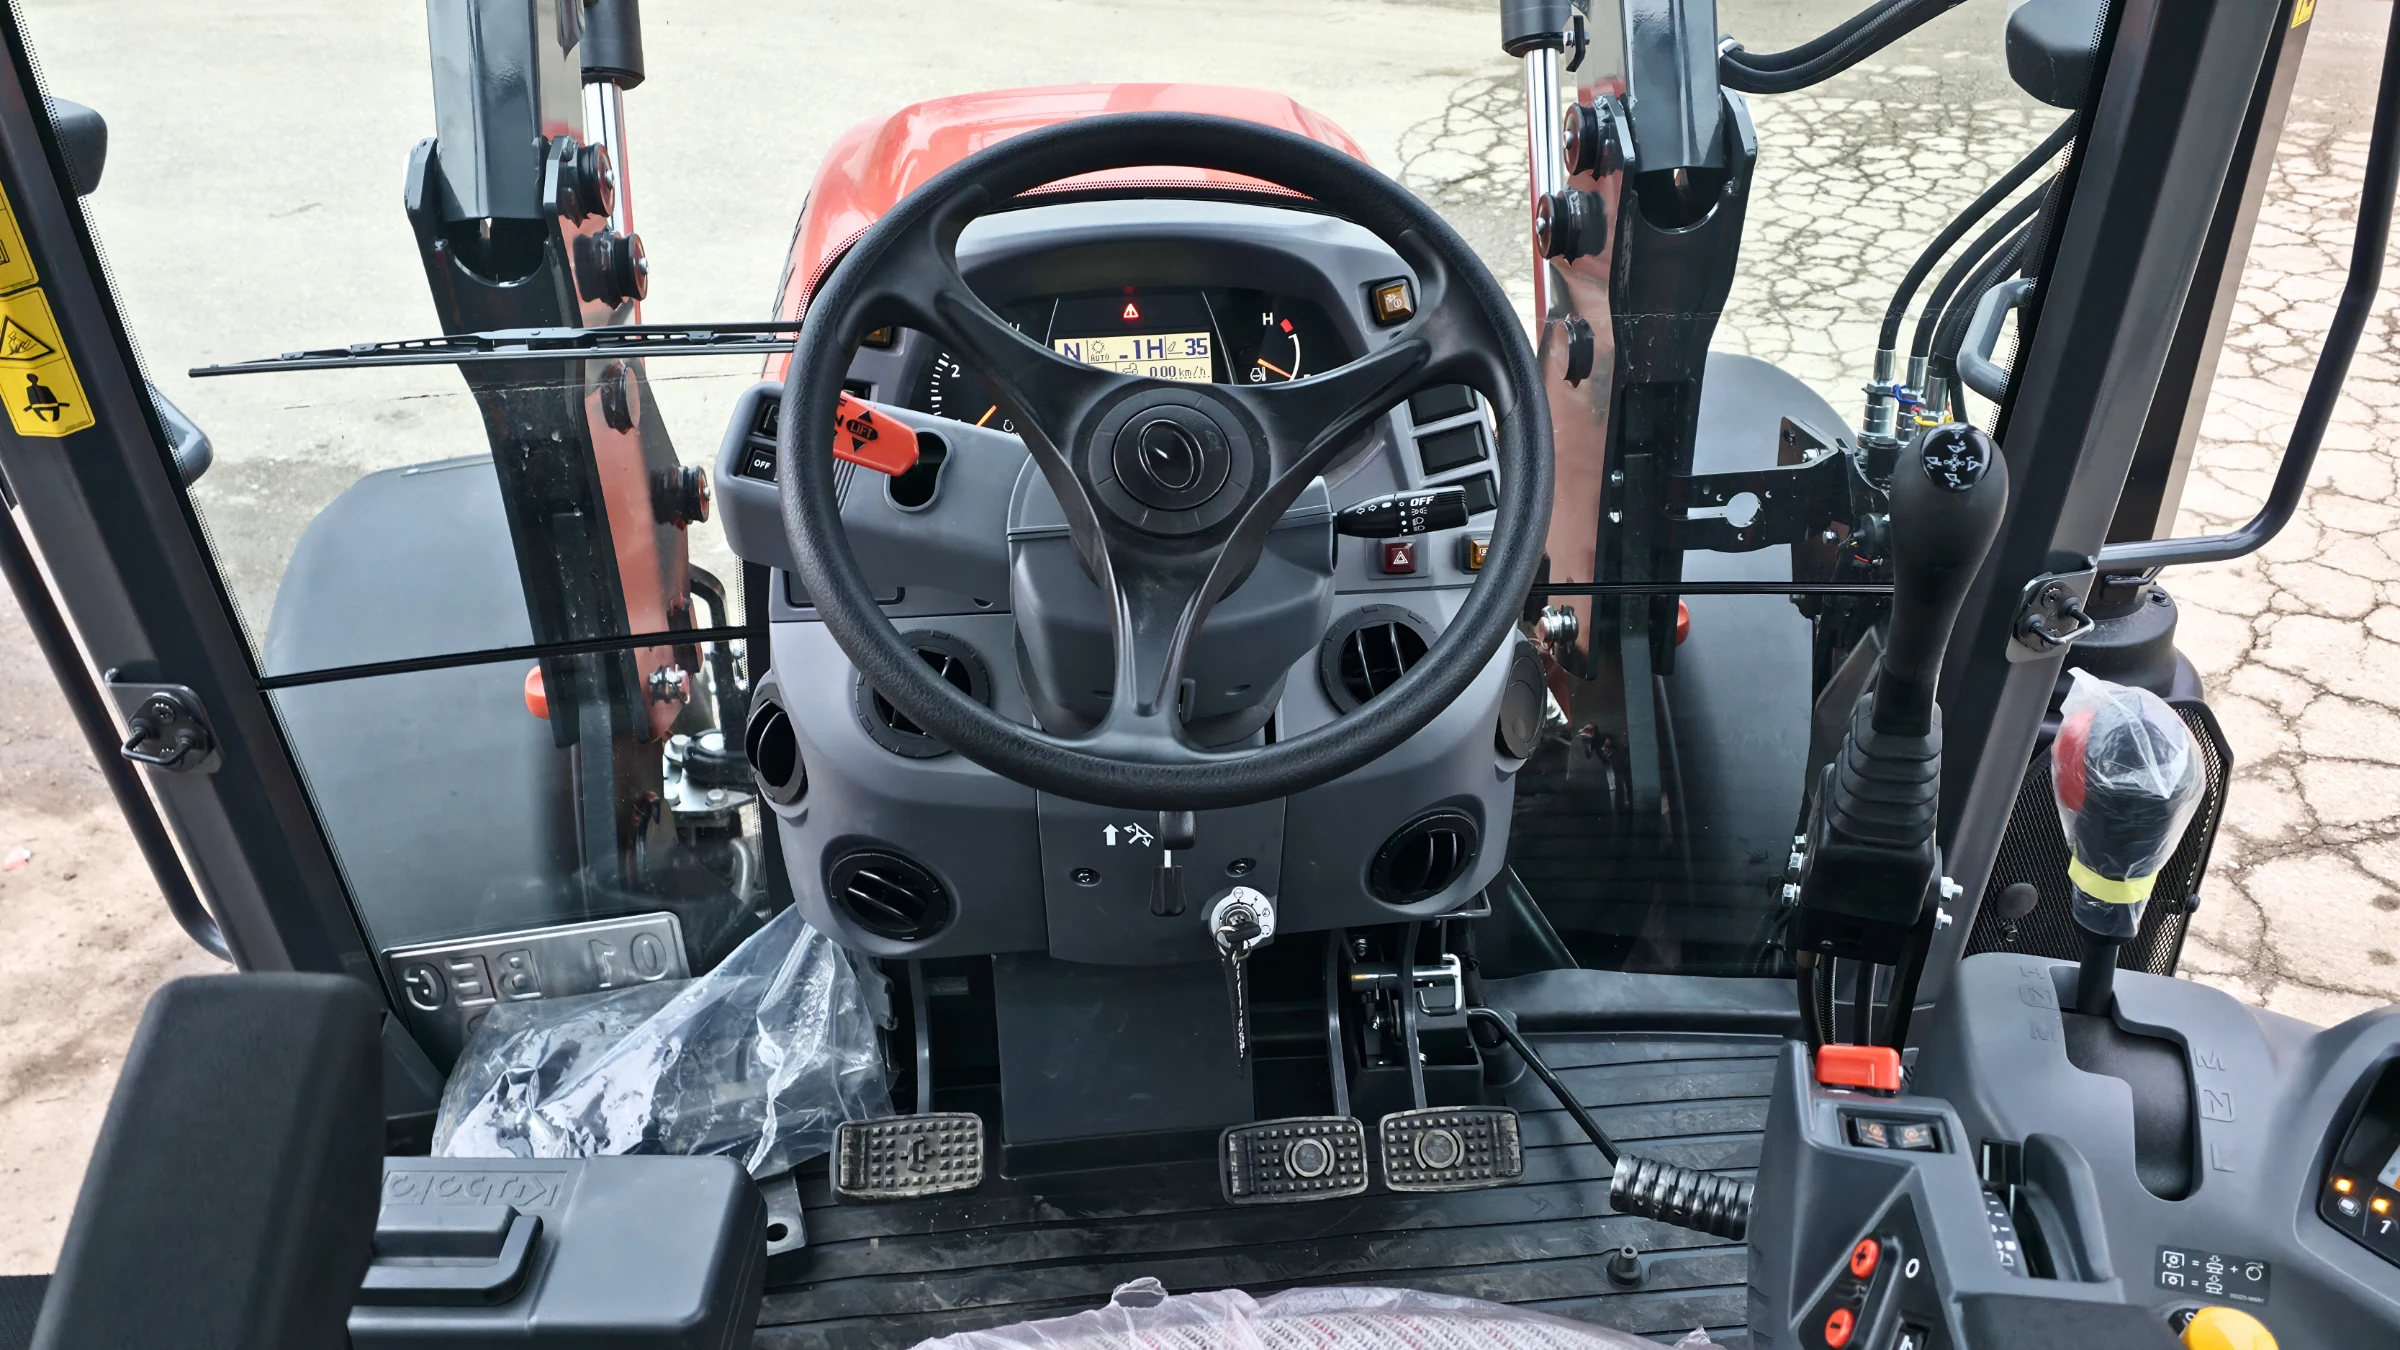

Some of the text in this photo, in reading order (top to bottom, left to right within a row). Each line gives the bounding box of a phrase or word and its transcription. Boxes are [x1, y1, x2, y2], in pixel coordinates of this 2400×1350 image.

[1262, 312, 1274, 326] H
[1063, 342, 1081, 361] N
[1185, 337, 1208, 356] 35
[1090, 353, 1110, 362] AUTO
[950, 364, 961, 378] 2
[1149, 365, 1207, 379] 0.00 km/h
[849, 420, 874, 440] LIFT
[754, 459, 771, 470] OFF
[1410, 495, 1435, 508] OFF
